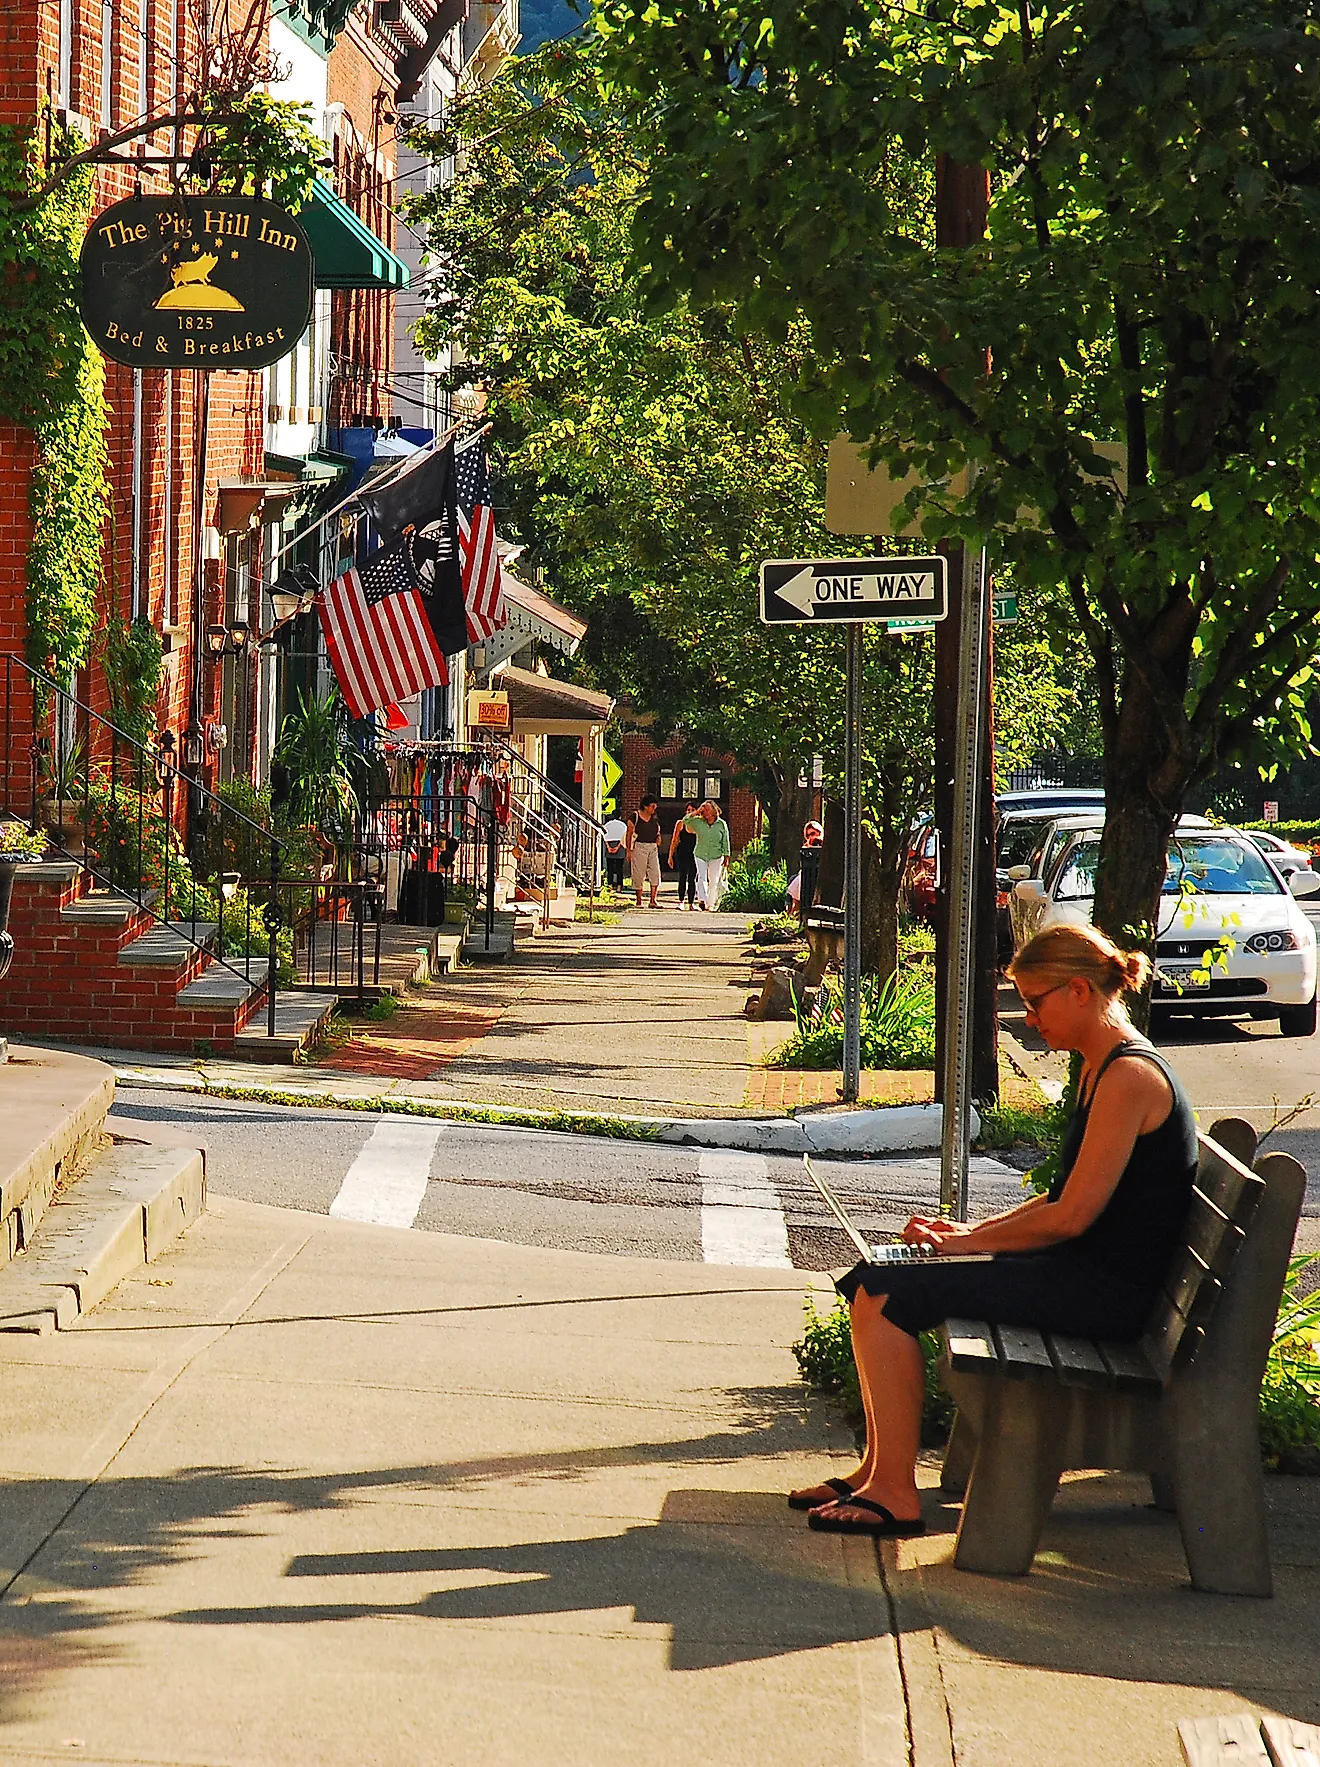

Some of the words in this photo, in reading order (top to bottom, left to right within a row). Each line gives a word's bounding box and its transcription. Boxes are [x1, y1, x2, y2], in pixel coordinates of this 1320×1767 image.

[98, 219, 148, 249] The
[155, 211, 193, 239] Pig
[203, 209, 250, 238] Hill
[256, 218, 298, 252] Inn
[177, 316, 214, 330] 1825
[105, 322, 144, 347] Bed
[155, 335, 169, 353] &
[184, 326, 285, 355] Breakfast
[815, 577, 864, 601] ONE
[876, 574, 927, 599] WAY
[992, 600, 1008, 618] ST
